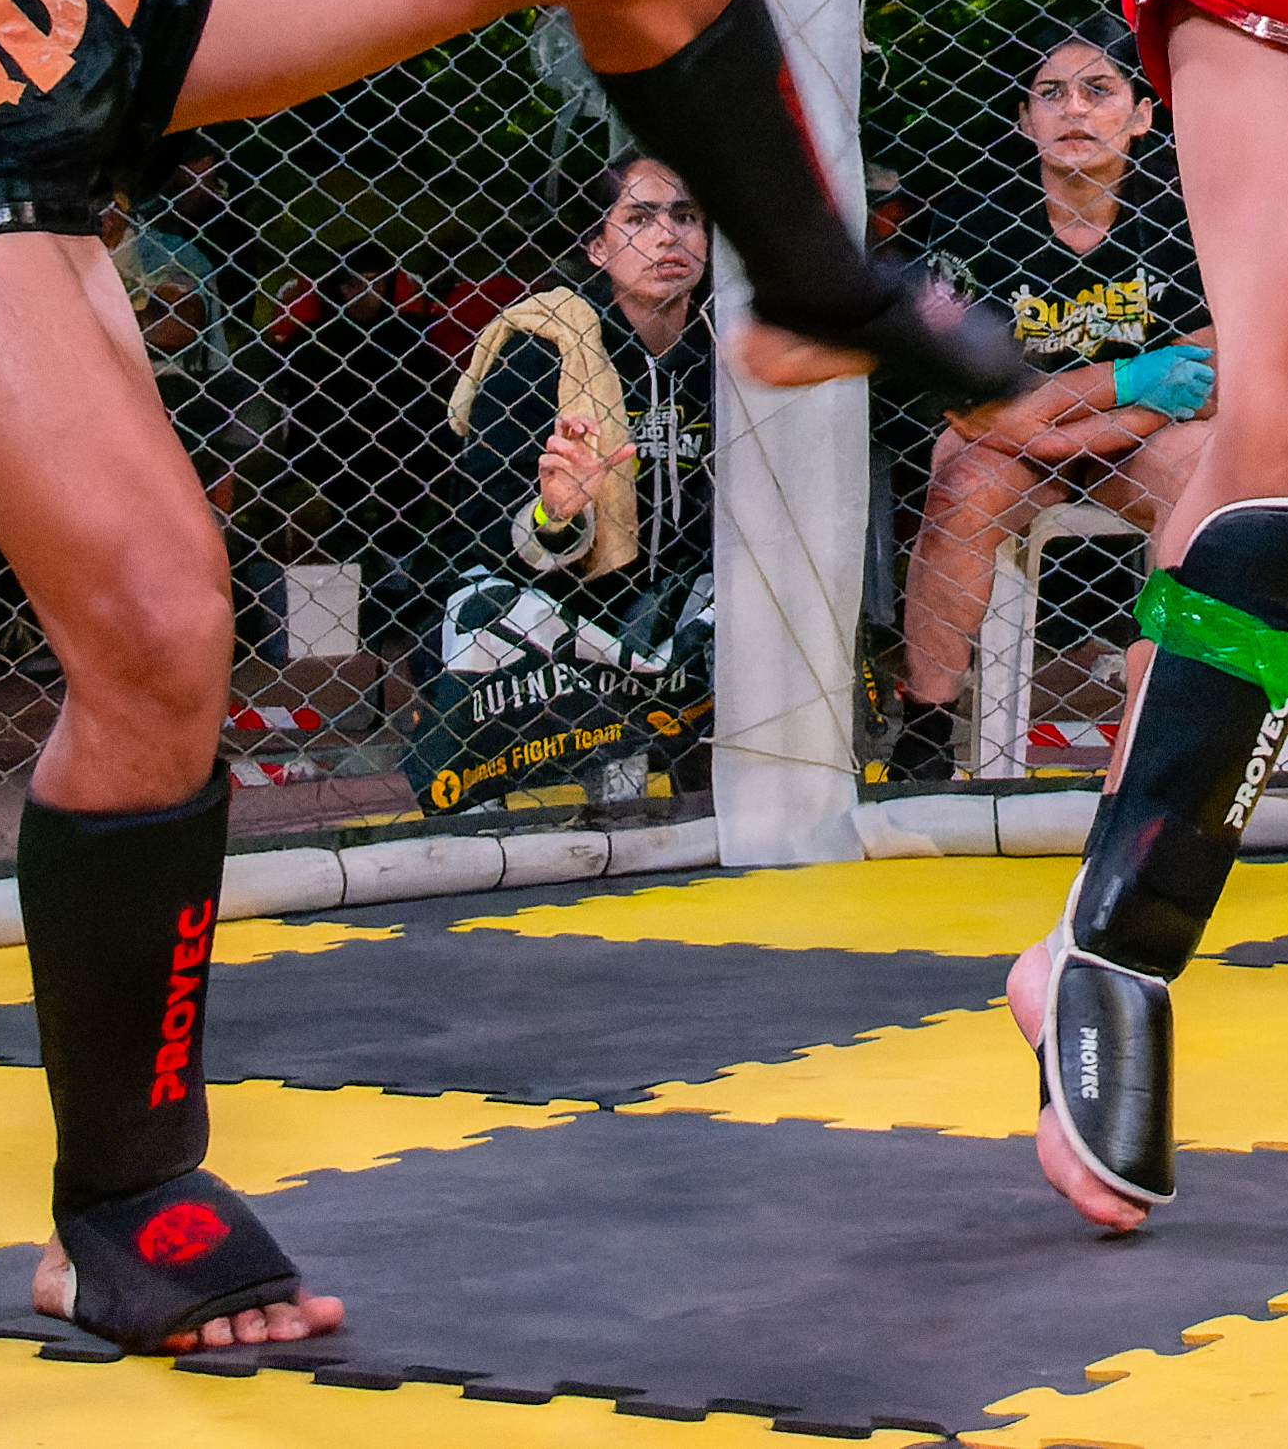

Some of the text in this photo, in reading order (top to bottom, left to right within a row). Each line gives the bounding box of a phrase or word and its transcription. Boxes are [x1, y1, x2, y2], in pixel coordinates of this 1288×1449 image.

[512, 733, 568, 770] FIGHT
[149, 898, 212, 1110] PROYEC
[1079, 1026, 1100, 1099] PROYEC
